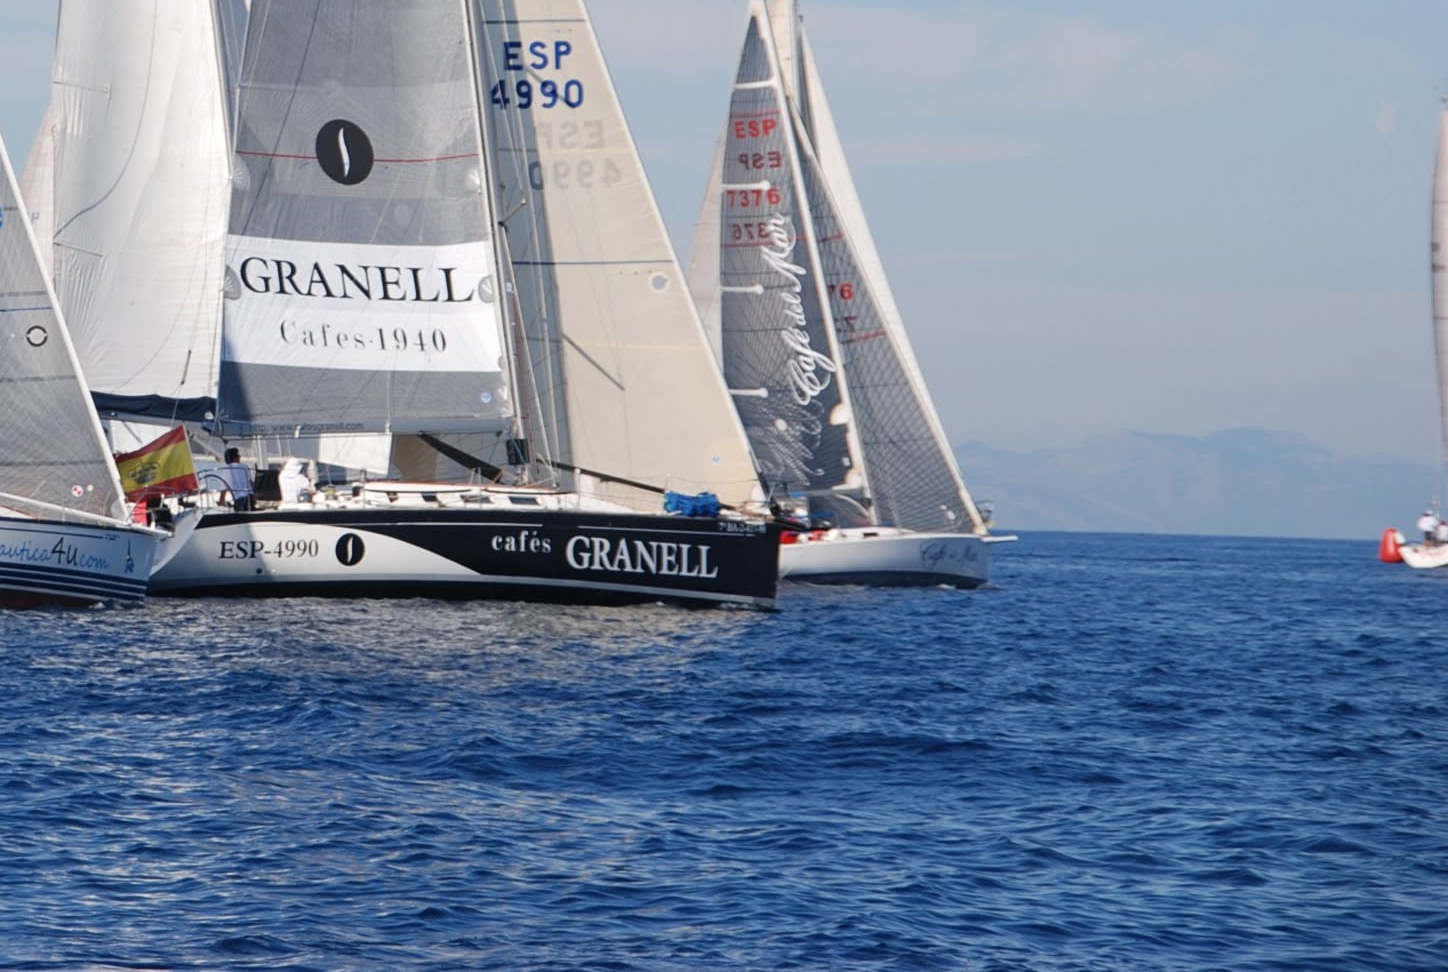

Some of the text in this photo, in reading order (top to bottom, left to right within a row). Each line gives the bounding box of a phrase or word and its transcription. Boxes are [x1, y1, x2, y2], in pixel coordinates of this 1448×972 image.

[503, 41, 572, 71] ESP
[490, 79, 584, 110] 4990
[734, 118, 776, 139] ESP
[727, 187, 782, 207] 7376
[761, 212, 807, 293] Mar
[240, 257, 476, 303] GRANELL
[781, 292, 807, 326] del
[218, 539, 319, 559] ESP-4990
[491, 531, 719, 578] cafés GRANELL
